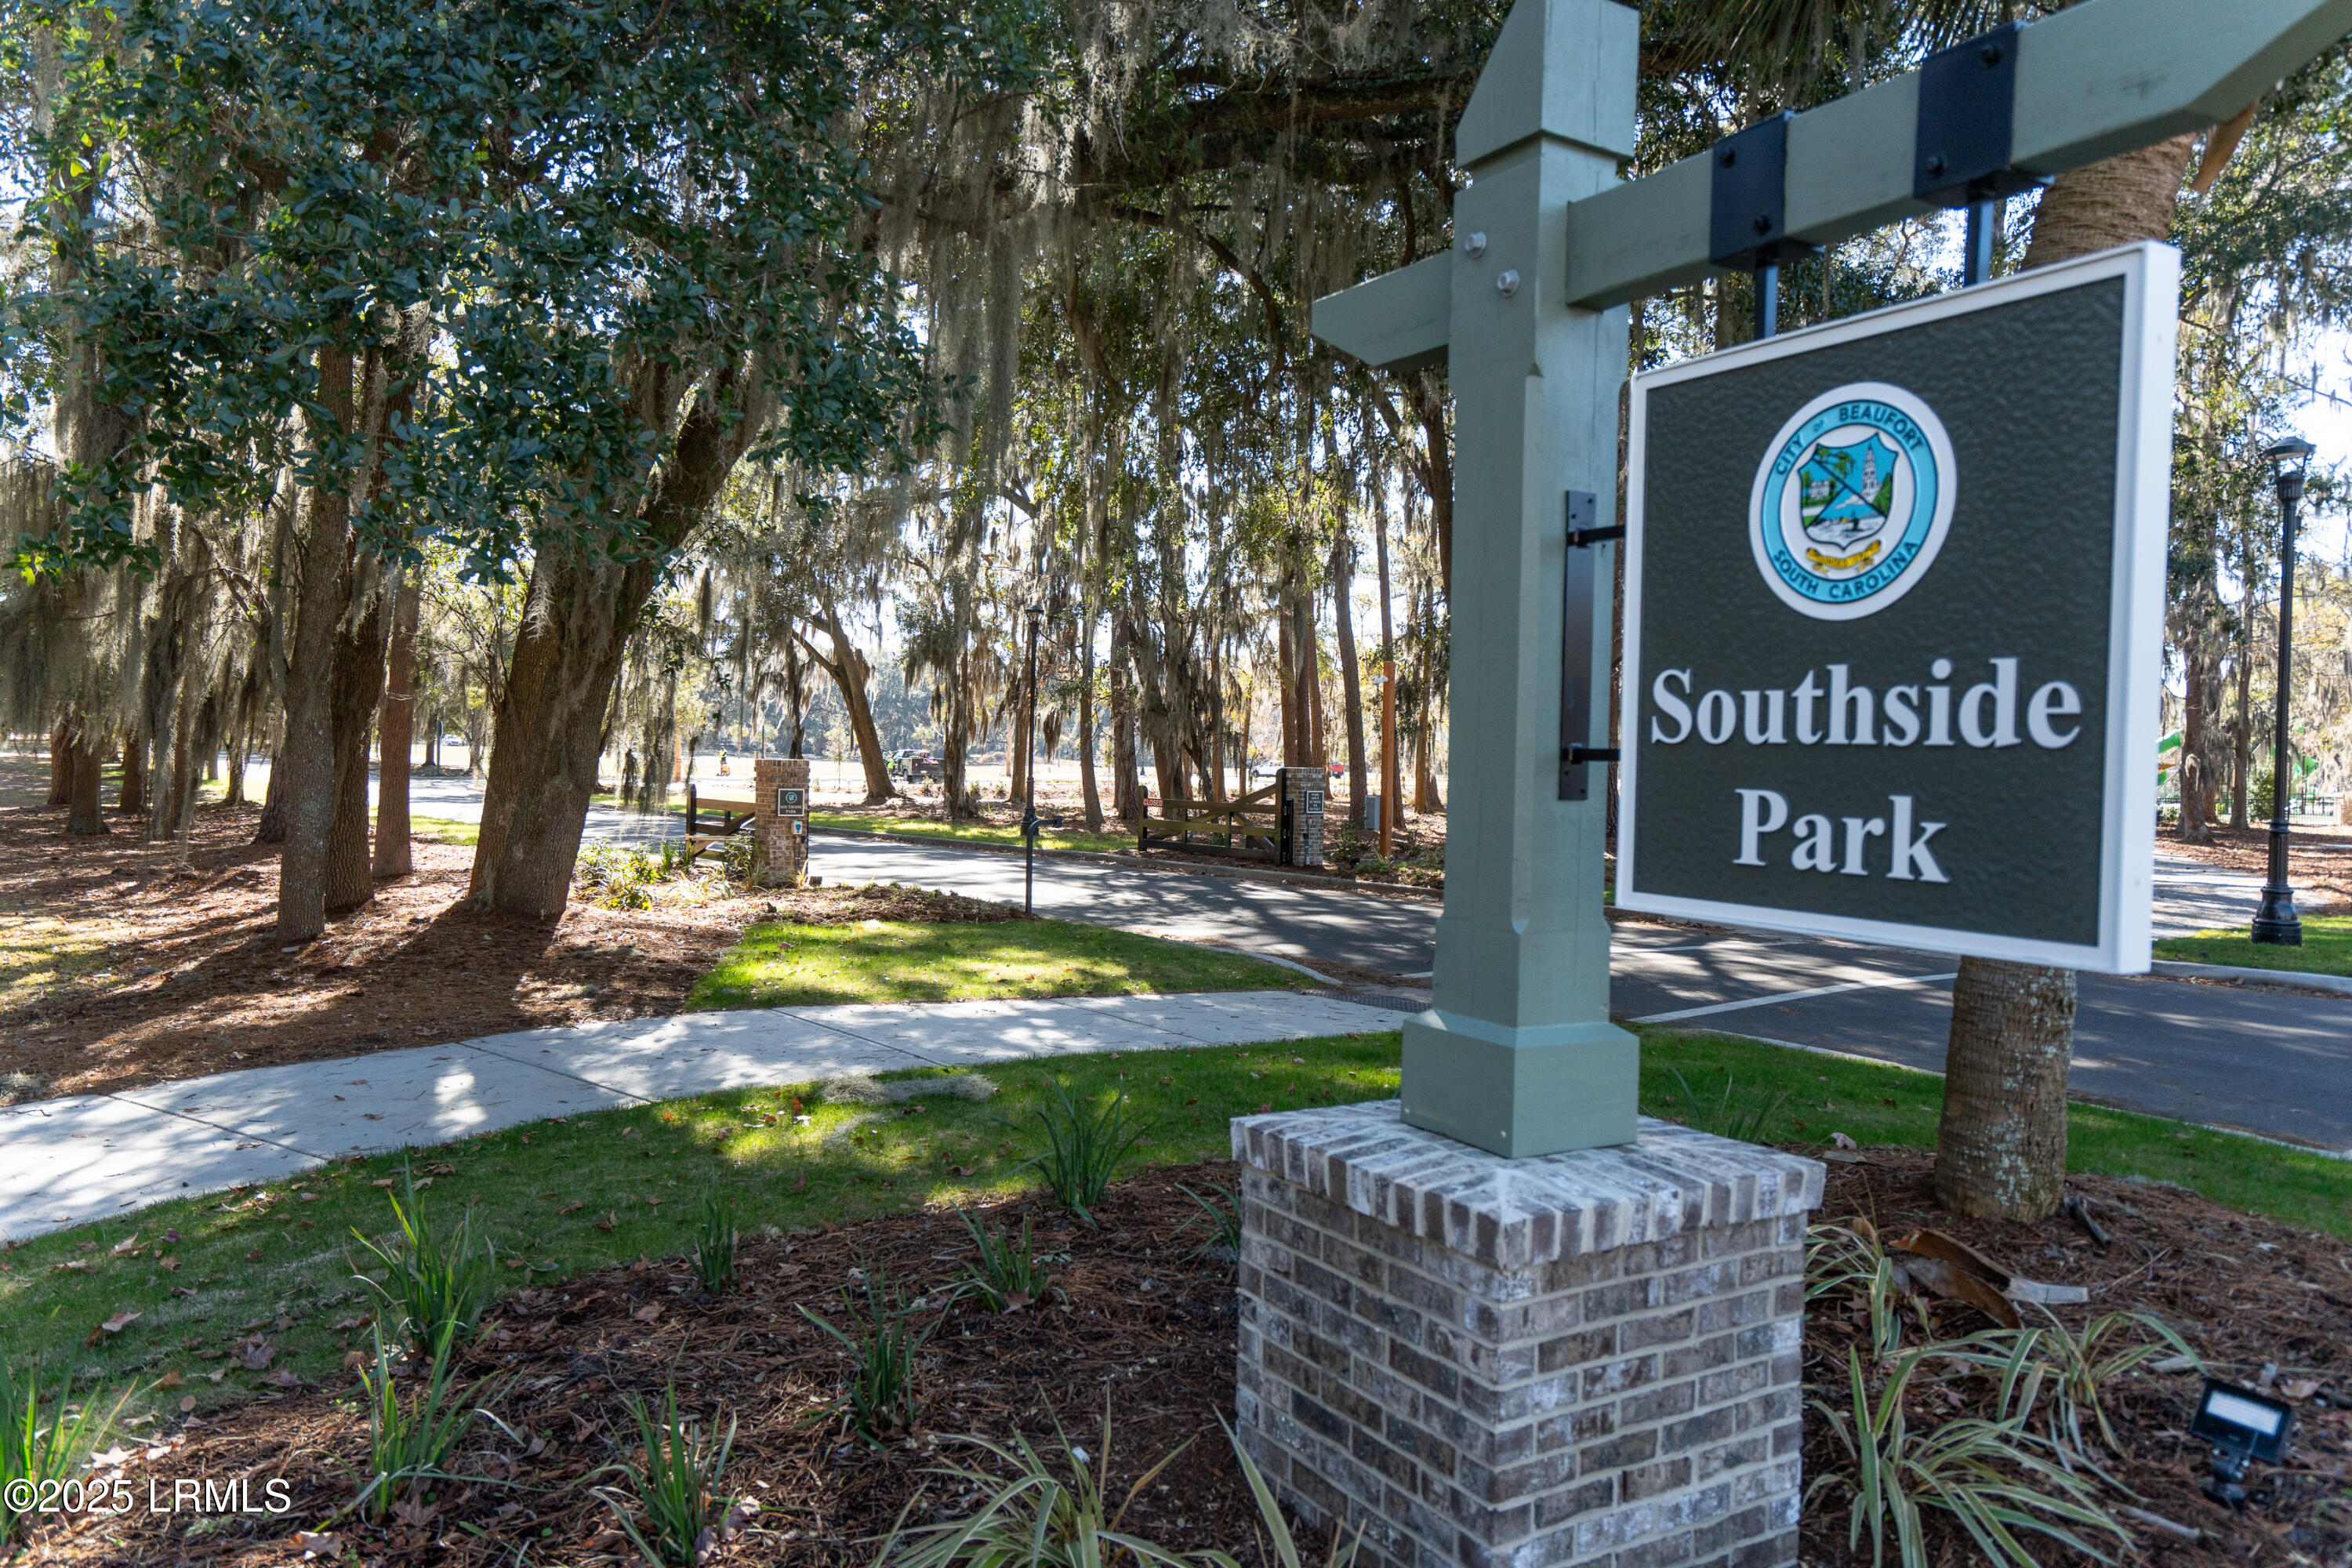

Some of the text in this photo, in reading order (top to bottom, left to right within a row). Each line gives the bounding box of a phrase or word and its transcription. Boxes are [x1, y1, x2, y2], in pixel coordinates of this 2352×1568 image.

[1774, 434, 1805, 476] CITY
[1838, 405, 1925, 452] BEAUFORT
[1773, 539, 1920, 600] SOUTH CAROLINA
[1651, 657, 2082, 750] Southside
[1733, 788, 1951, 884] Park
